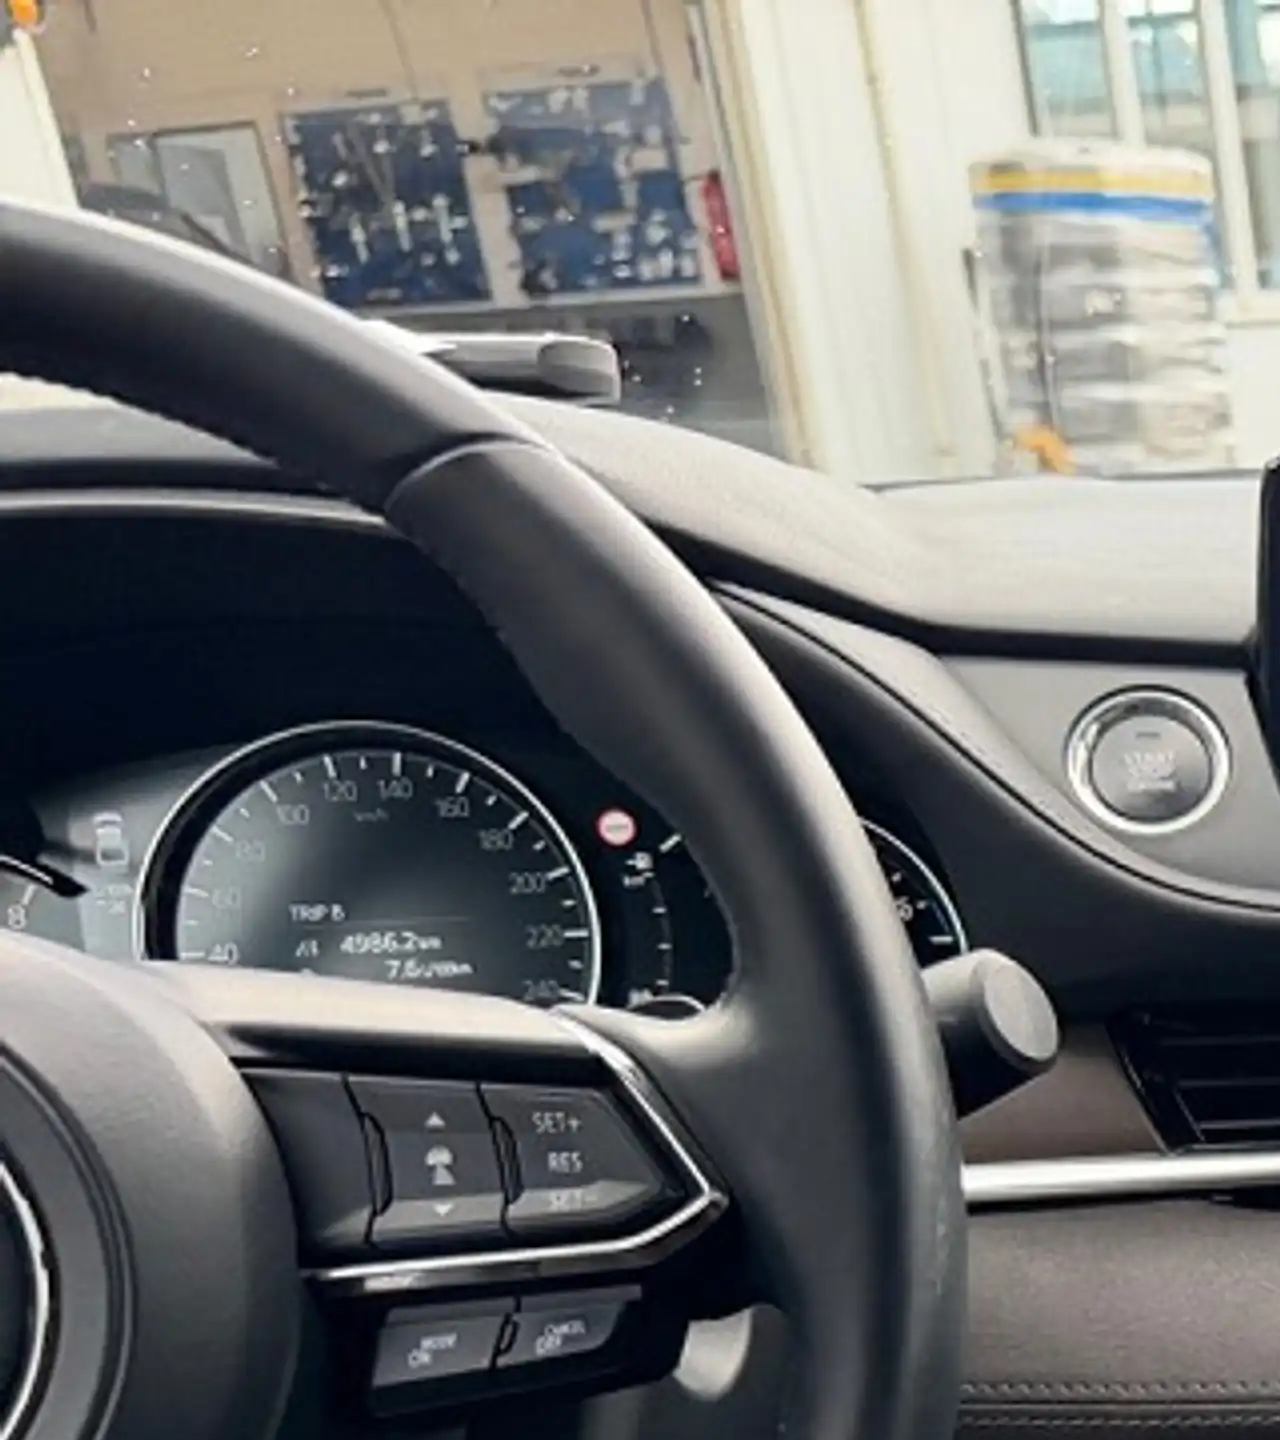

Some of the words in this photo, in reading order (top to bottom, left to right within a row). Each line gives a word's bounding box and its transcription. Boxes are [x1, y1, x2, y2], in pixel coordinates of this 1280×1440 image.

[323, 780, 358, 801] 120
[377, 778, 414, 799] 140
[478, 829, 514, 851] 180
[509, 872, 547, 895] 200
[7, 904, 27, 930] 8
[525, 924, 564, 948] 220
[207, 942, 238, 966] 40
[531, 1111, 583, 1135] SET+
[547, 1150, 584, 1174] RES
